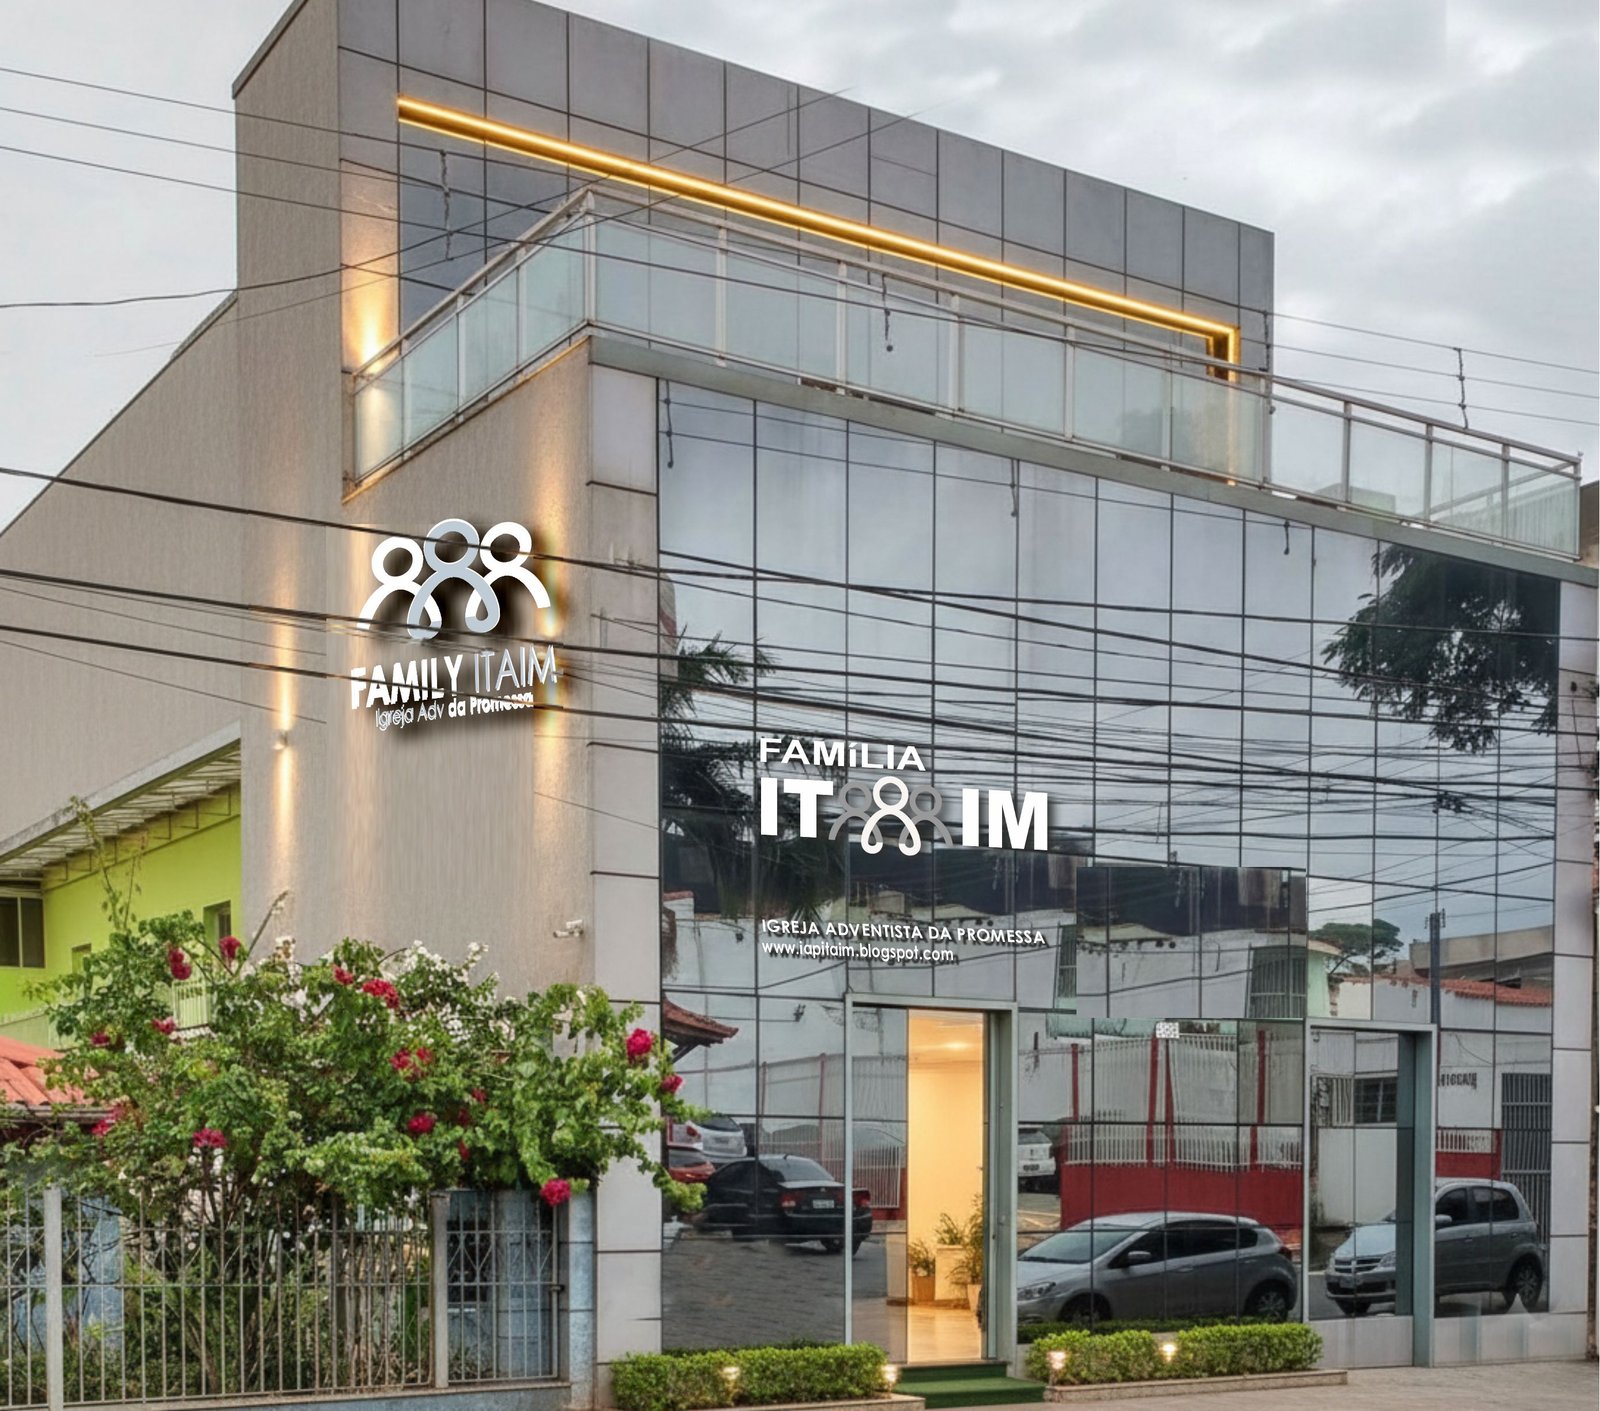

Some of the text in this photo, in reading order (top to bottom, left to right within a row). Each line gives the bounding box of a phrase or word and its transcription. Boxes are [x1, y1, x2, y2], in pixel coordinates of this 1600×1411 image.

[351, 645, 558, 709] FAMILY ITAIM
[375, 702, 414, 731] Igreja
[417, 701, 445, 722] Adv
[448, 697, 466, 718] da
[761, 919, 1046, 945] IGREJA ADVENTISTA DA PROMESSA
[761, 940, 955, 962] www.iapitaim.blogspot.com
